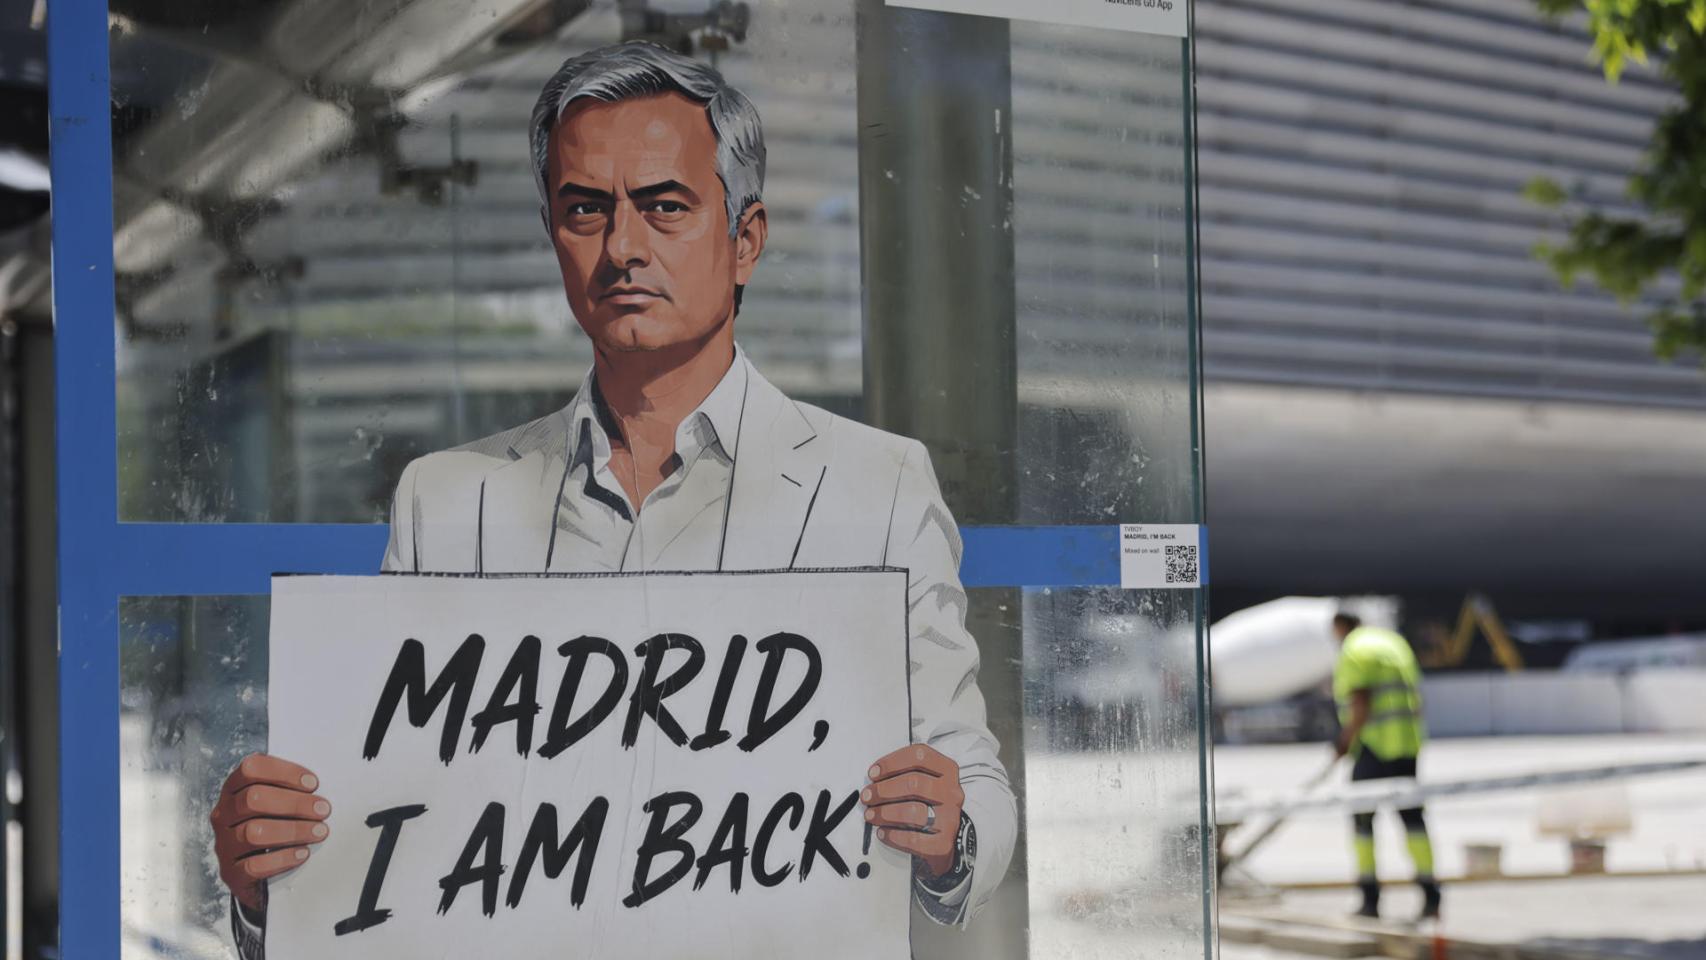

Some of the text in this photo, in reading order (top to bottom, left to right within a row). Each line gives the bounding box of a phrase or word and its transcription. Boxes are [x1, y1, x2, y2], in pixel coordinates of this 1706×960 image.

[1157, 0, 1173, 11] App
[362, 631, 830, 767] MADRID,
[334, 788, 873, 936] I AM BACK!
